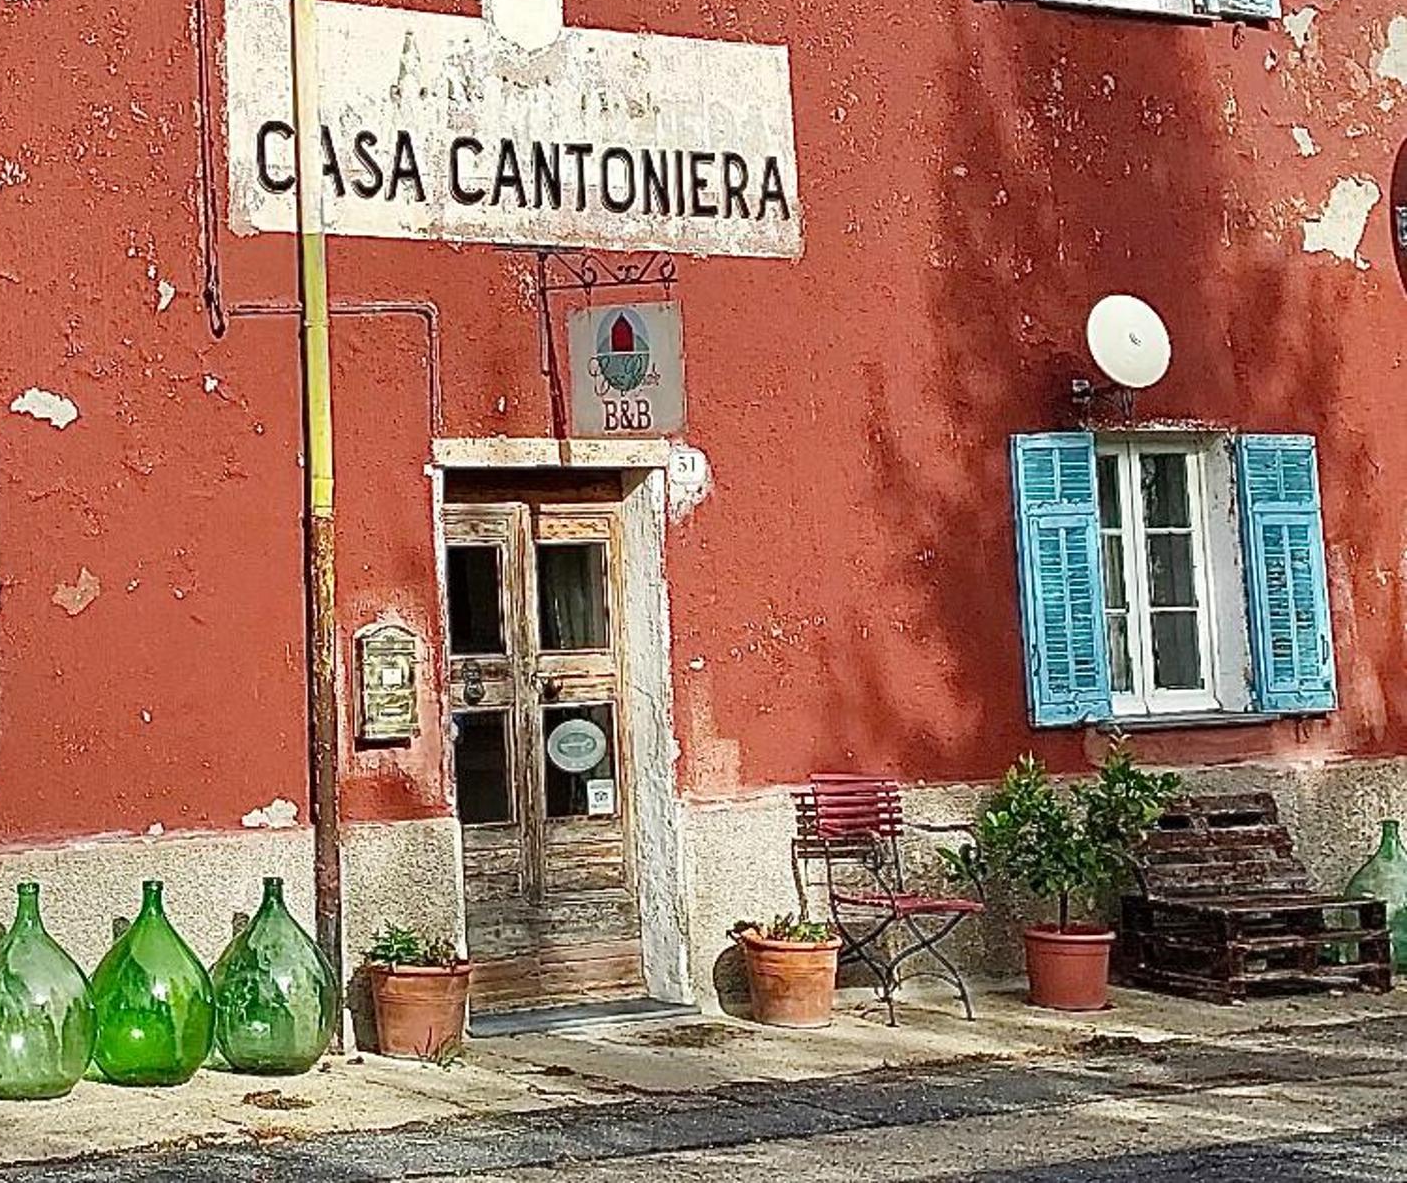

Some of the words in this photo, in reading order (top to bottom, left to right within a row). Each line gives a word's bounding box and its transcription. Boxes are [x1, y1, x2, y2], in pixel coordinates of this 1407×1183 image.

[256, 120, 427, 202] CASA
[449, 136, 791, 221] CANTONIERA
[602, 399, 652, 431] B&B
